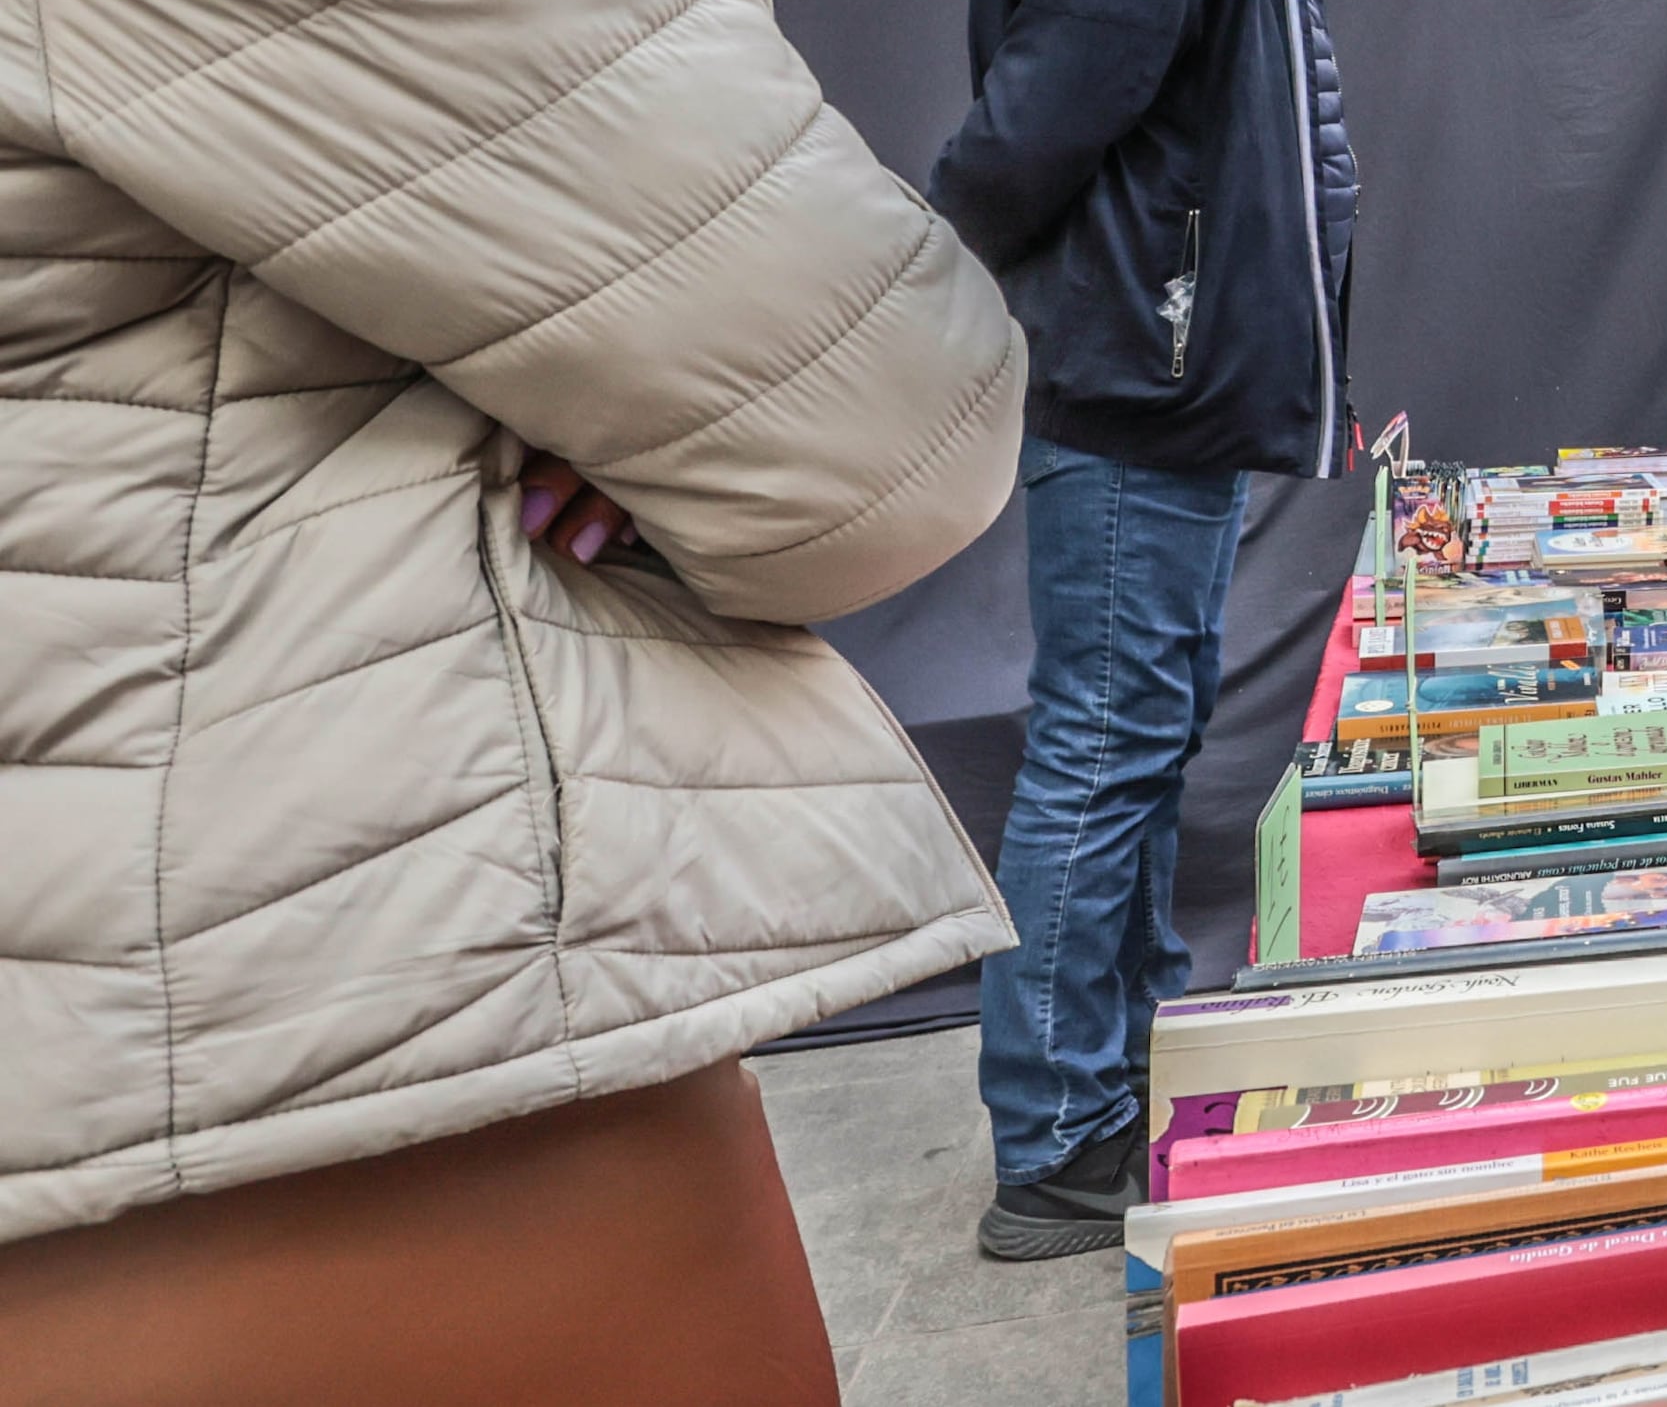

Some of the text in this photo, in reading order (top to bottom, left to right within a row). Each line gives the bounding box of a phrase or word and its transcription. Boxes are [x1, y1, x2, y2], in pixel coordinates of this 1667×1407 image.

[1514, 778, 1558, 790] LIBERMAN
[1588, 769, 1662, 784] Gustav Mahler
[1585, 820, 1615, 830] Susana
[1574, 858, 1620, 874] pequeñas
[1622, 858, 1639, 868] las
[1642, 856, 1656, 866] de
[1461, 870, 1532, 886] ARUNDATHI ROY
[1365, 975, 1520, 998] Noah Gordon
[1607, 1075, 1638, 1089] FUE
[1342, 1177, 1370, 1188] Lisa
[1437, 1167, 1455, 1177] sin
[1460, 1160, 1514, 1174] nombre
[1604, 1228, 1655, 1245] Ducal
